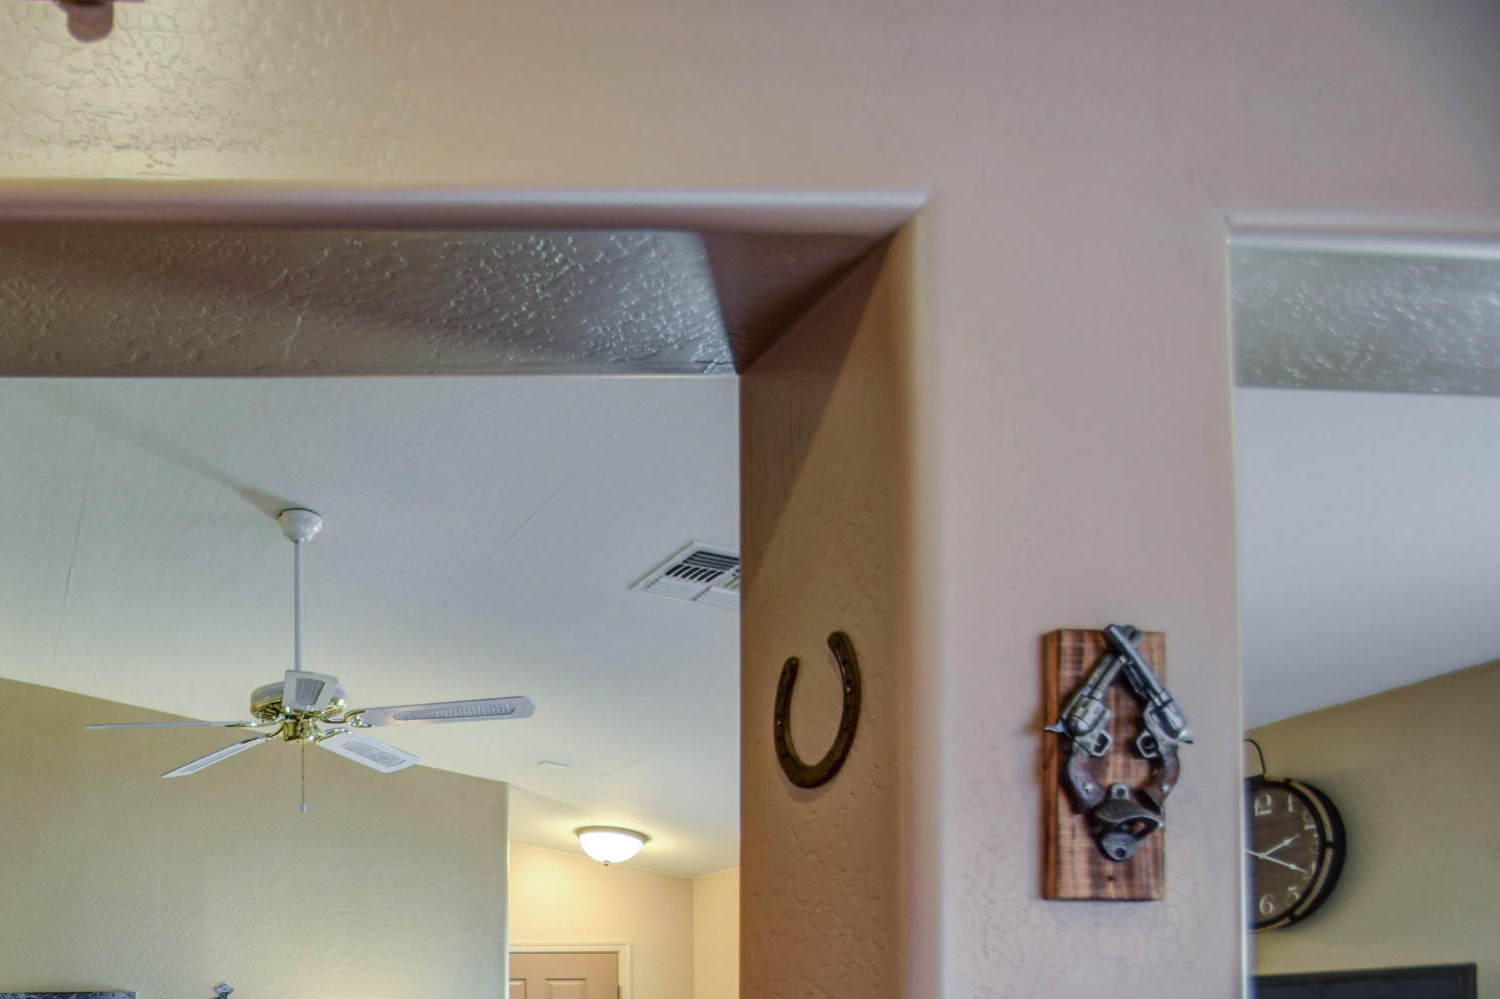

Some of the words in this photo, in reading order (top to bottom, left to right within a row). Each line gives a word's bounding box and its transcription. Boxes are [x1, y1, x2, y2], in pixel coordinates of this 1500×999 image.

[1254, 793, 1272, 817] 12
[1287, 795, 1294, 813] 1
[1259, 894, 1274, 915] 6
[1284, 886, 1300, 906] 5
